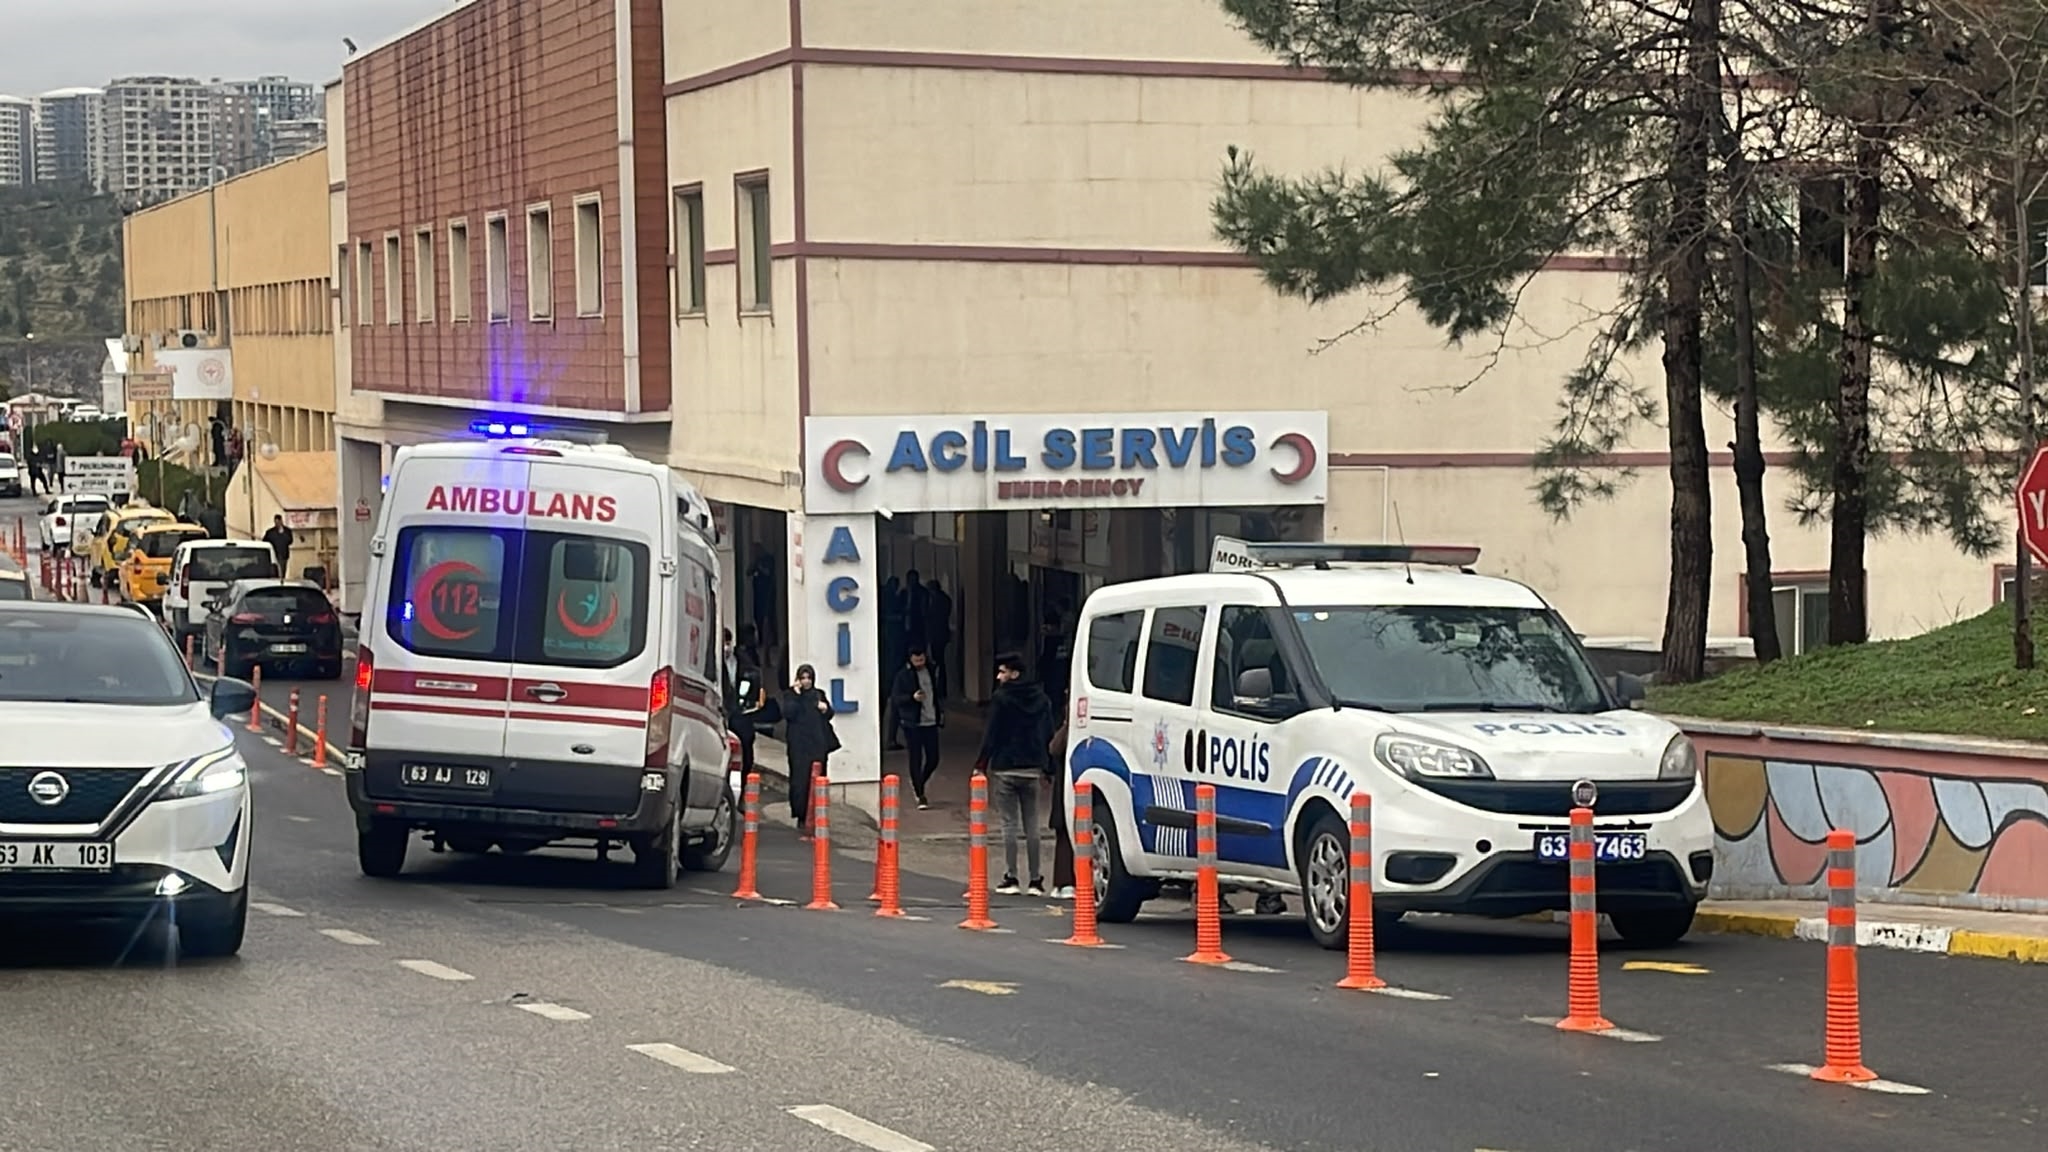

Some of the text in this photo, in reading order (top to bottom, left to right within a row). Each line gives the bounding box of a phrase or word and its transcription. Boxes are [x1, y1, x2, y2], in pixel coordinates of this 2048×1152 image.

[885, 417, 1257, 473] ACİL SERVİS
[426, 485, 617, 523] AMBULANS
[998, 478, 1145, 500] EMERGENCY
[2028, 489, 2048, 531] Y
[435, 582, 479, 616] 112
[1211, 732, 1269, 783] POLİS
[411, 765, 487, 785] 63 AJ 129
[33, 845, 54, 865] AK
[78, 845, 108, 865] 103
[1540, 836, 1646, 859] 63 7463
